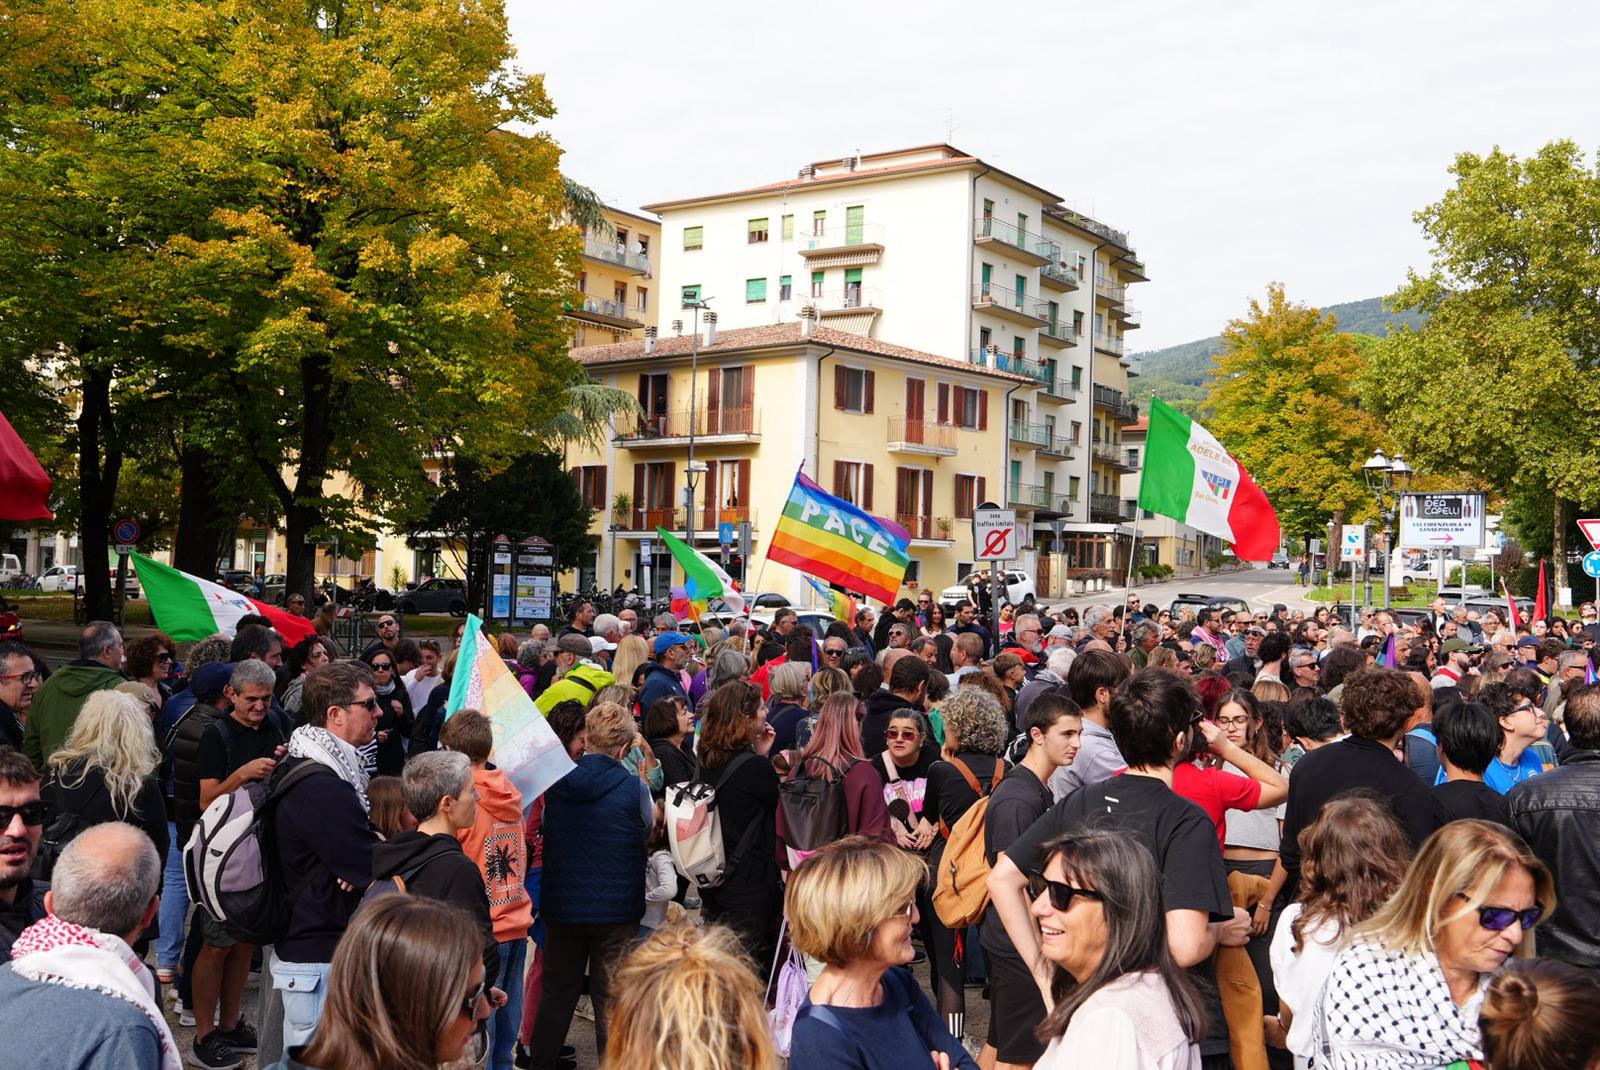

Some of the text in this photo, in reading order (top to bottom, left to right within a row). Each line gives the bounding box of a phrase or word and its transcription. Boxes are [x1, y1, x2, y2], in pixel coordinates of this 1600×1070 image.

[1190, 444, 1221, 461] ADELE
[1424, 499, 1446, 507] IDEA
[1424, 507, 1460, 515] CAPELLI
[800, 499, 895, 556] PACE
